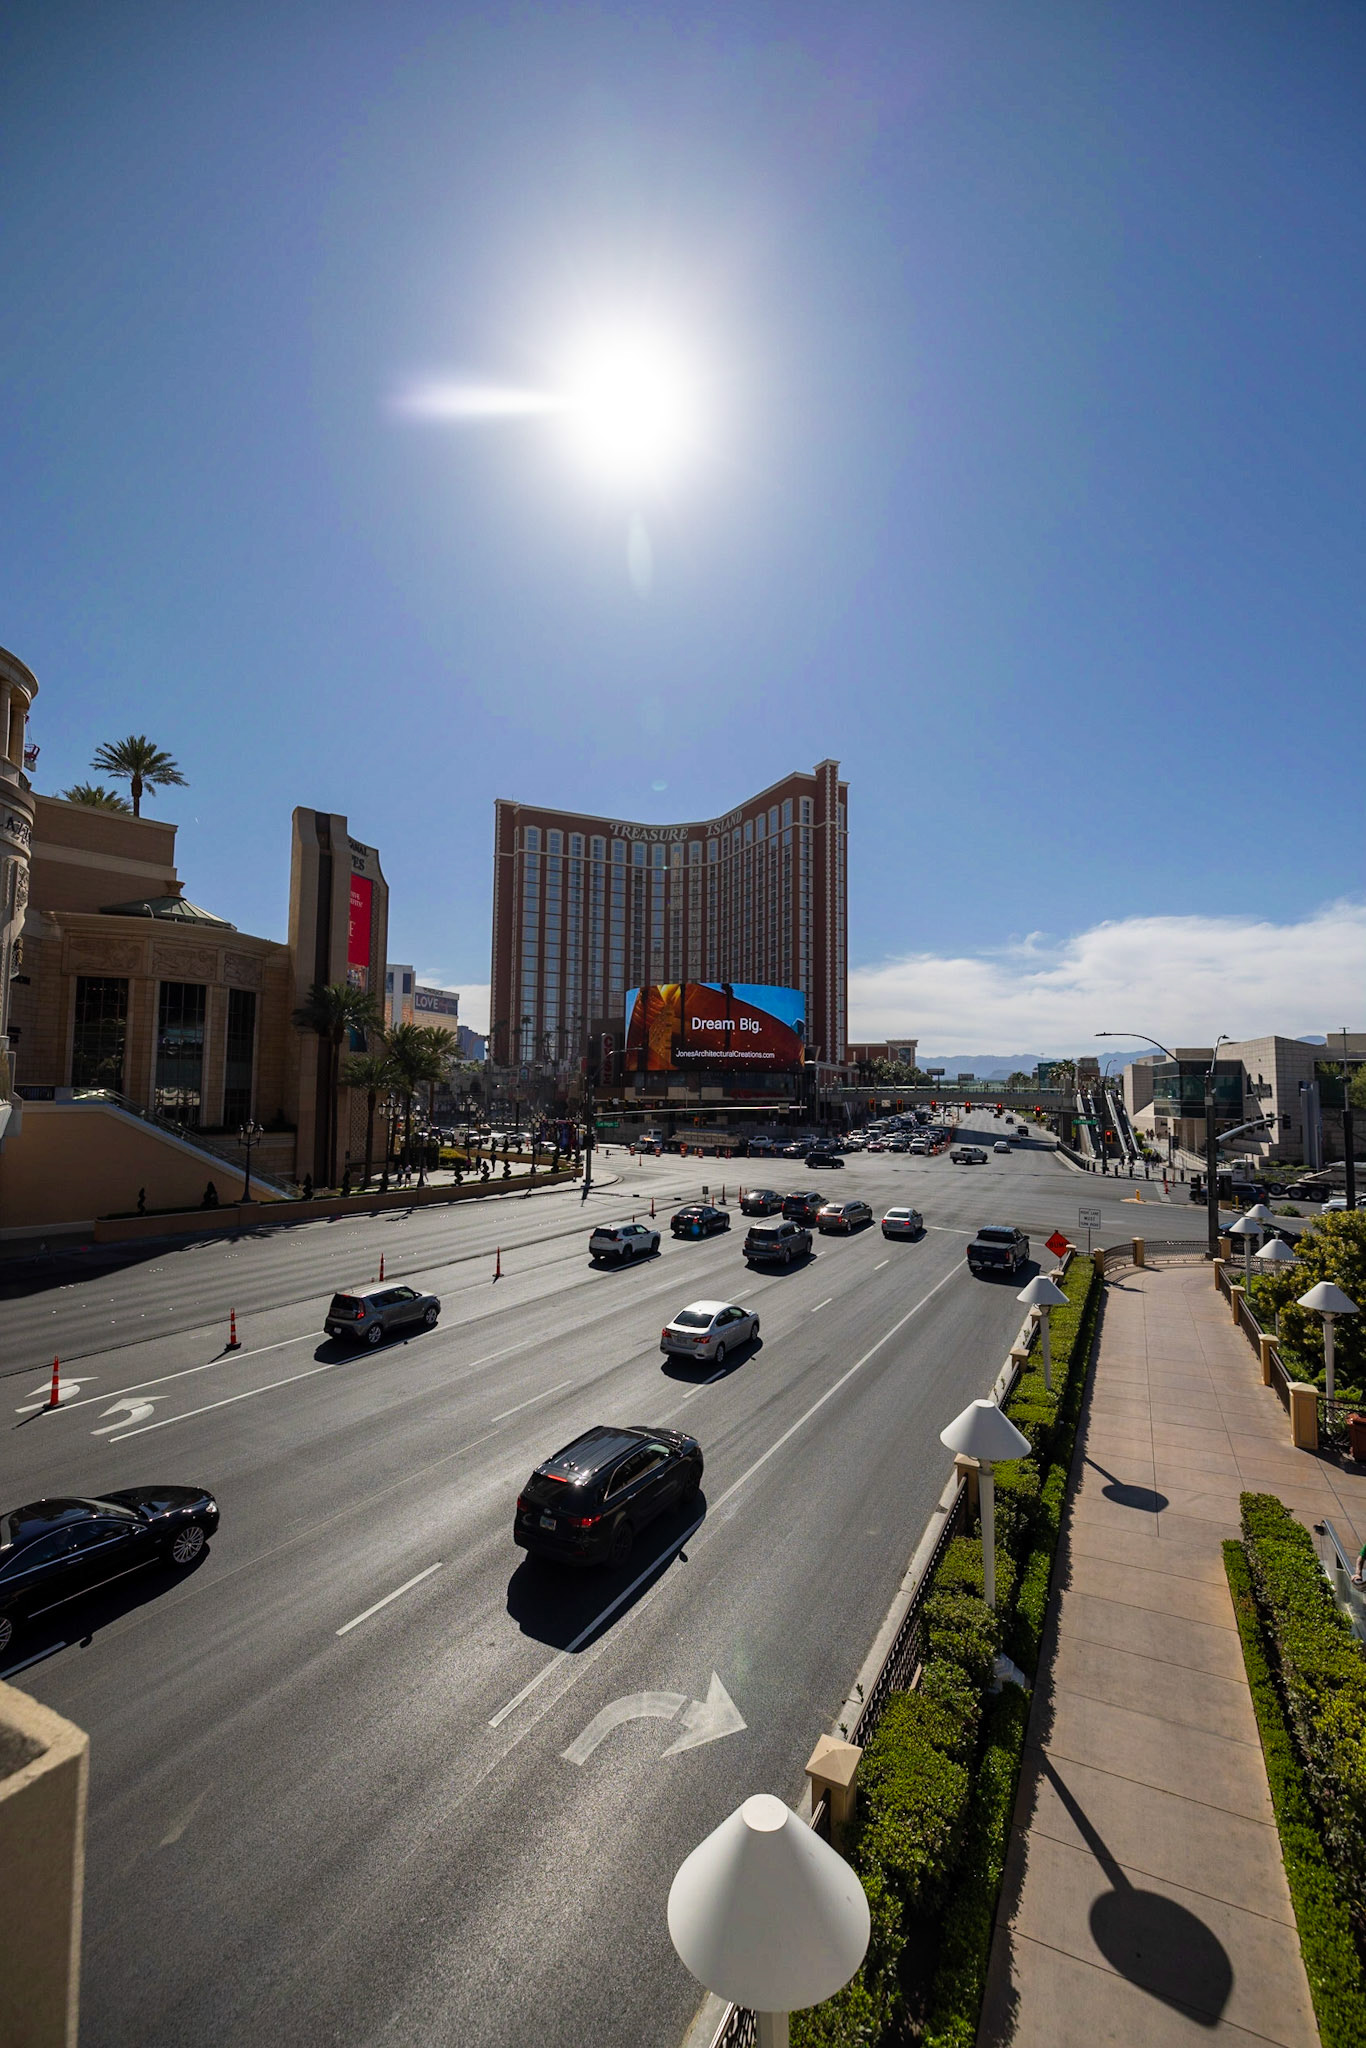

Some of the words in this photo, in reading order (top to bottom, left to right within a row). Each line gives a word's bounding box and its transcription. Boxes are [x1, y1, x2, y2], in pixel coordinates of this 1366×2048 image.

[609, 823, 689, 842] TREASURE
[704, 810, 743, 838] ISLAND
[415, 994, 440, 1010] LOVE
[691, 1017, 735, 1031] Dream
[739, 1017, 763, 1034] Big.
[675, 1049, 775, 1059] JonesArchitecturalCreations.com
